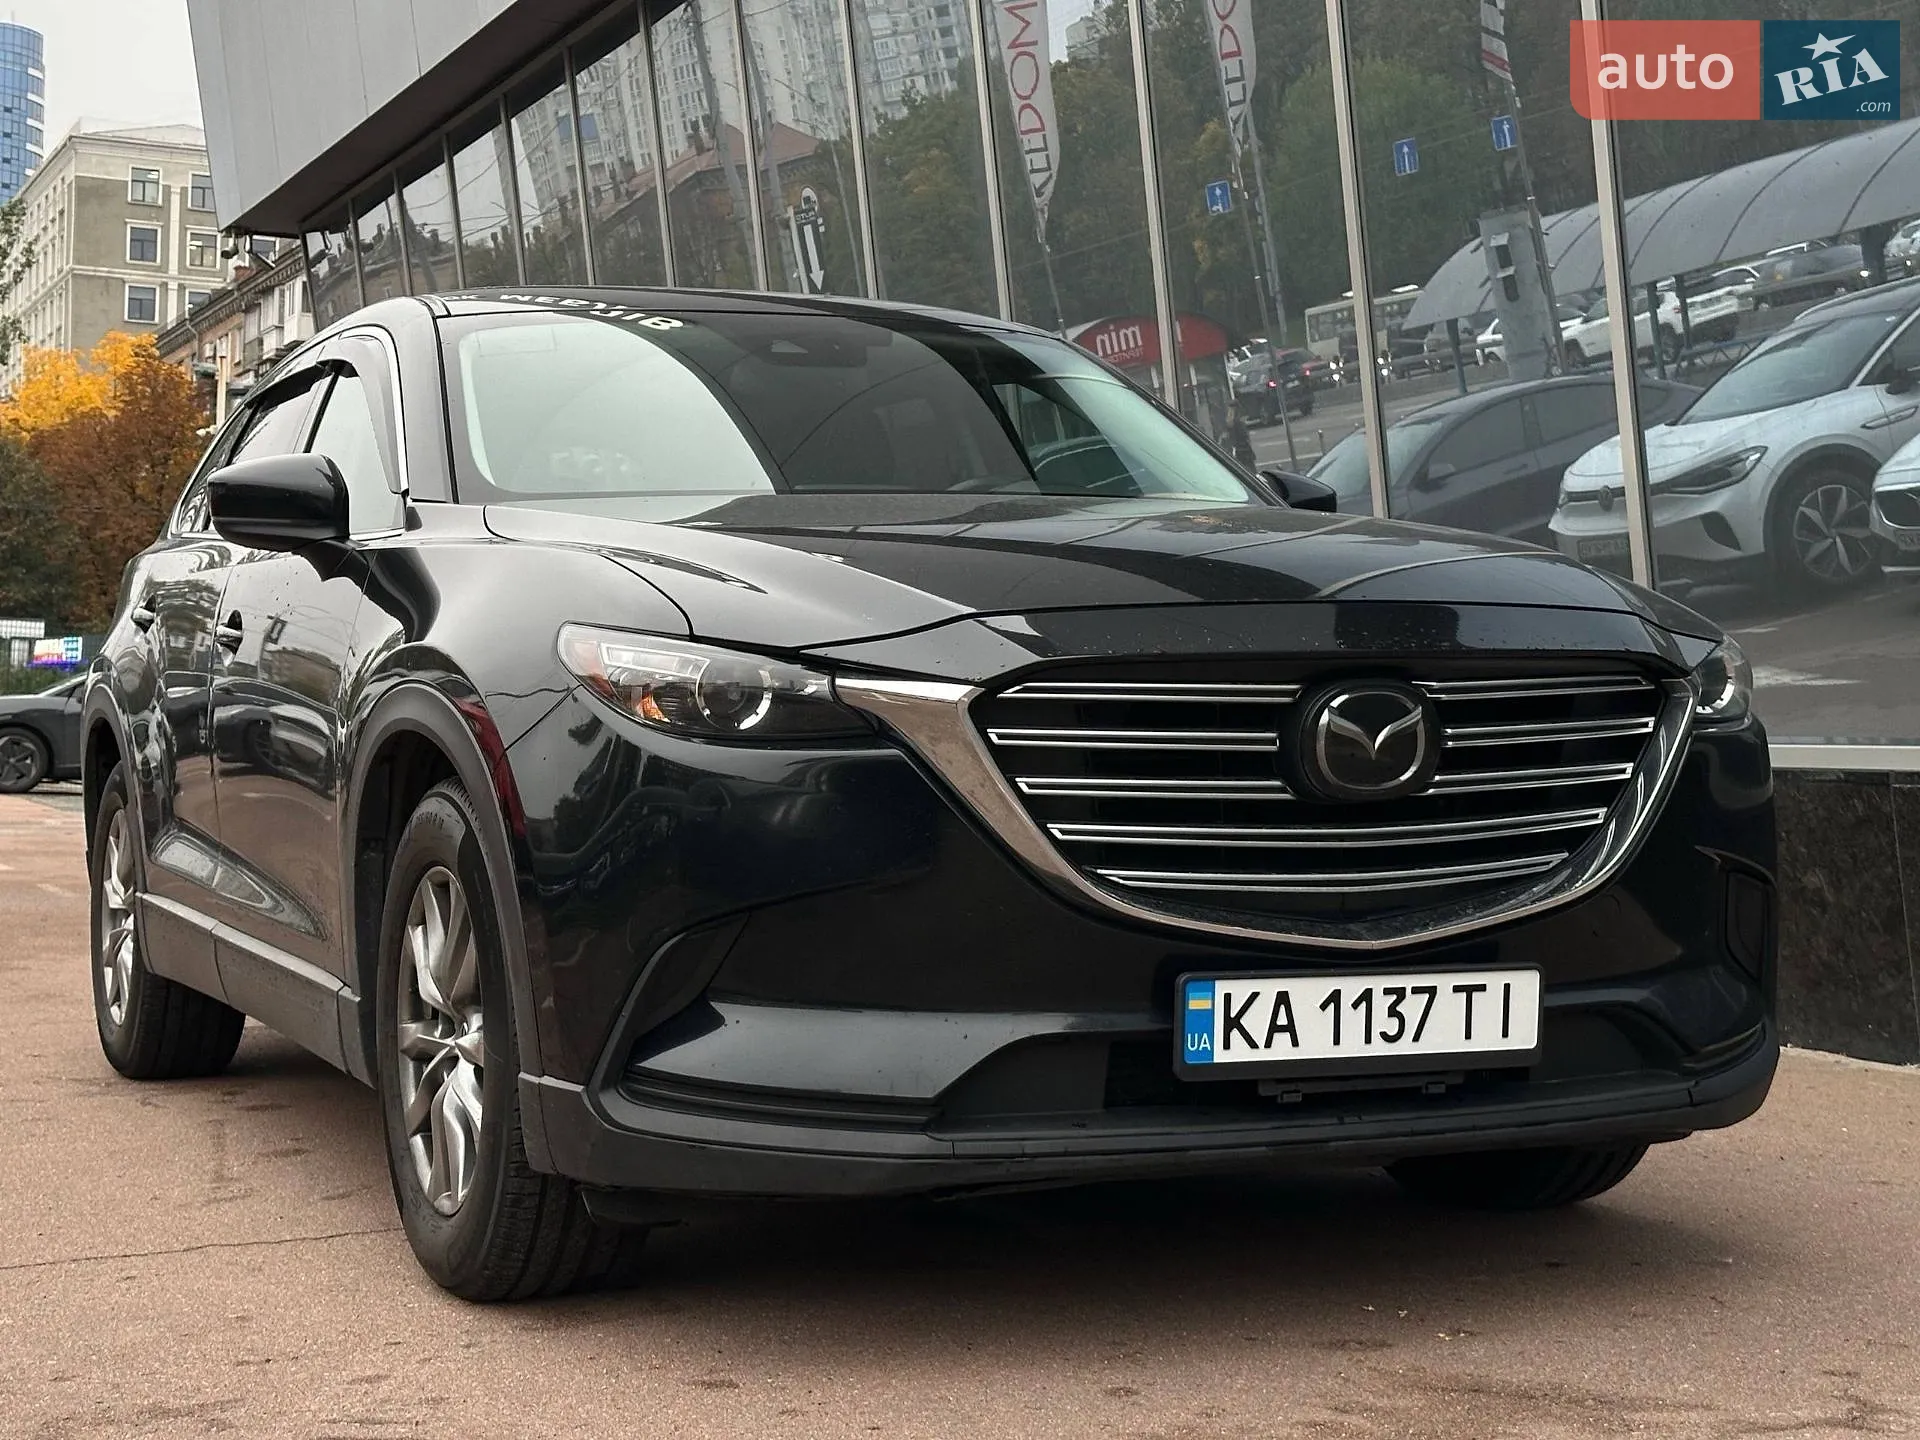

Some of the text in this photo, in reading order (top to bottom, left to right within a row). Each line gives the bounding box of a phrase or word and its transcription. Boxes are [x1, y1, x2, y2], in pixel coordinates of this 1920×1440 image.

[1222, 982, 1511, 1050] KA 1137 TI
[1187, 1032, 1211, 1051] UA
